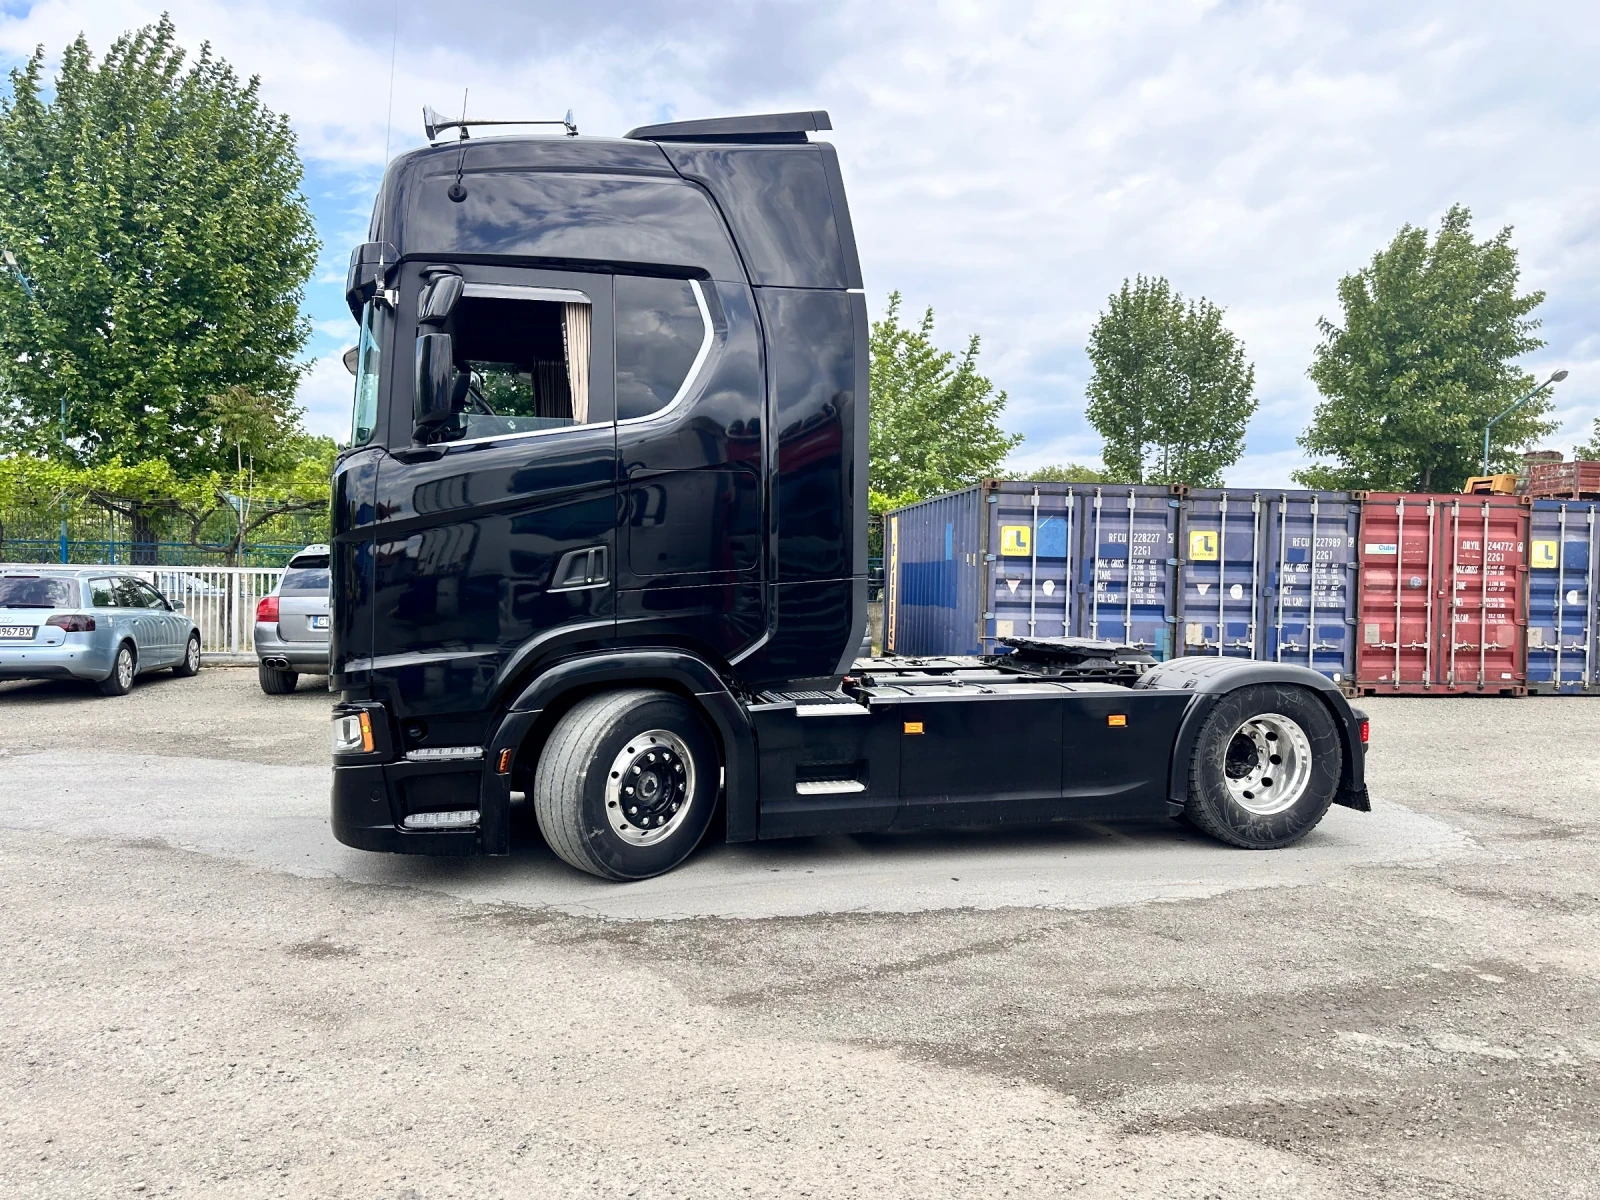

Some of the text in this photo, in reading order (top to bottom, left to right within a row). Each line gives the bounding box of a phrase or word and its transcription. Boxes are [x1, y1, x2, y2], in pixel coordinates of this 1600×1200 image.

[1109, 533, 1174, 544] RFCU 228227 5
[1293, 538, 1310, 547] RFCU
[1316, 538, 1341, 547] 227989
[1133, 546, 1151, 556] 22G1
[1488, 542, 1514, 551] 244772
[1317, 551, 1332, 560] 22G1
[1488, 554, 1504, 562] 22G1
[1099, 571, 1111, 580] TARE
